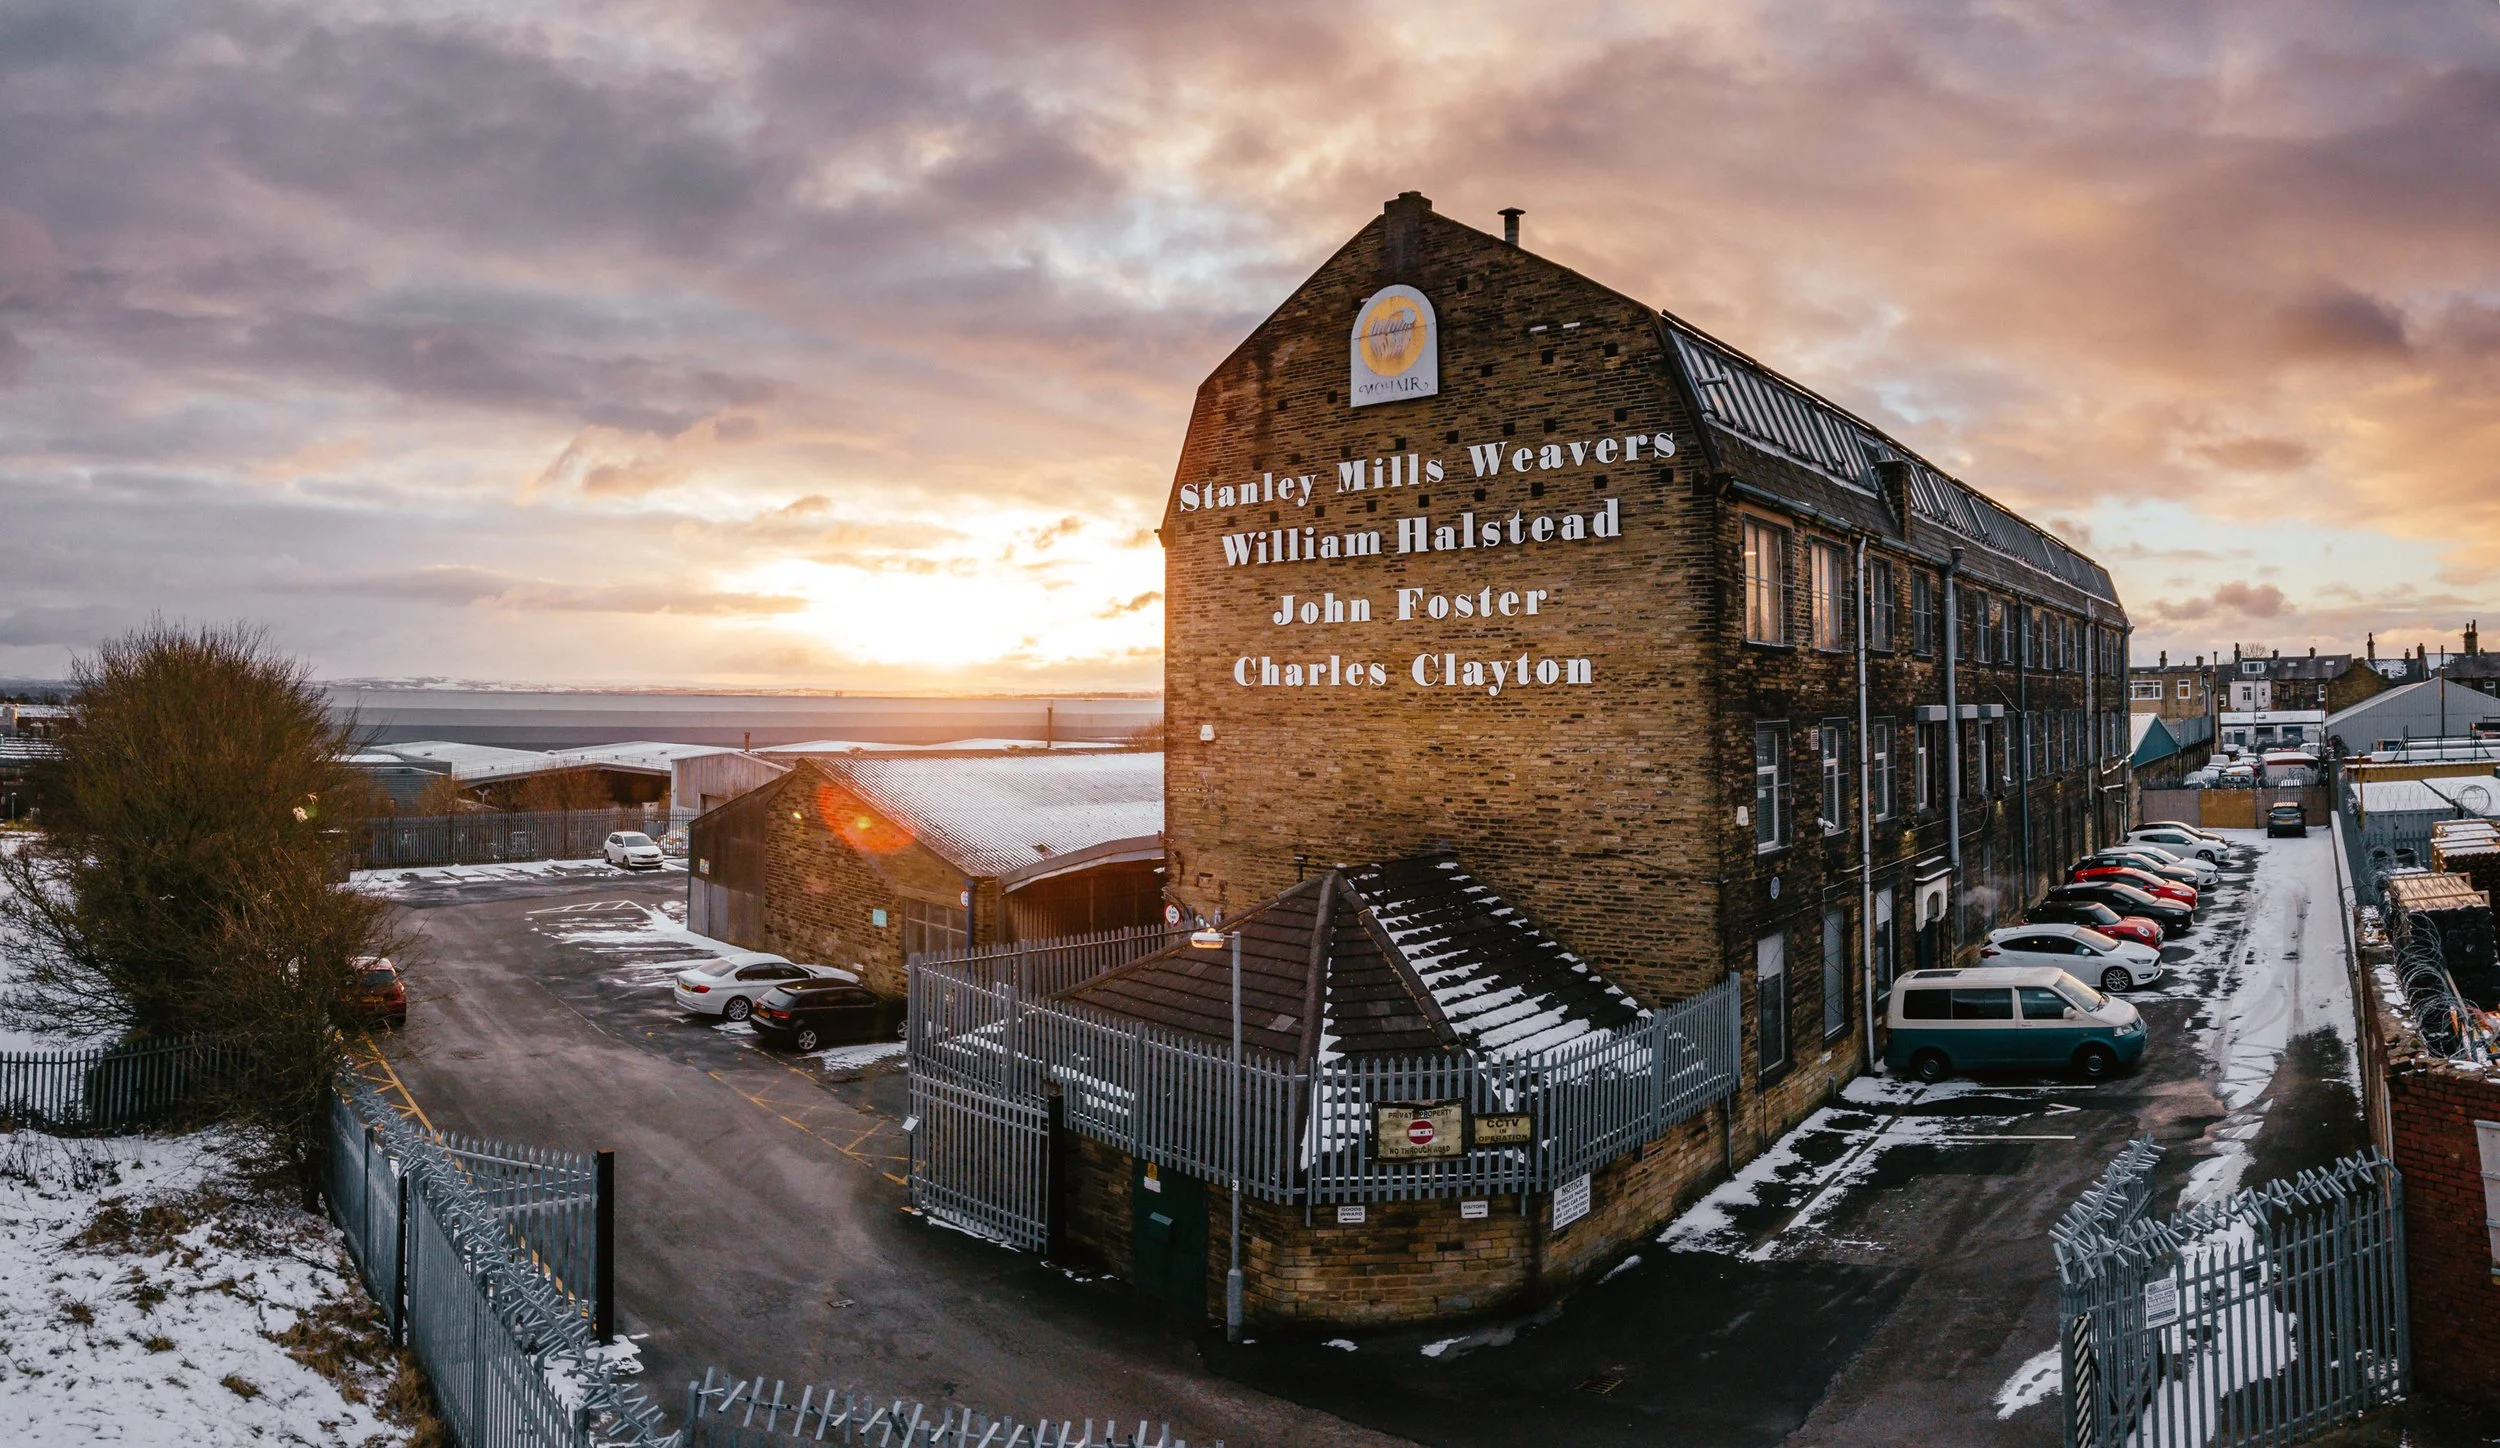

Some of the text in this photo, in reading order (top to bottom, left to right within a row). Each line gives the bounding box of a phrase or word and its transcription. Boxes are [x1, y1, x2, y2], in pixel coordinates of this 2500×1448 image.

[1180, 433, 1676, 512] Stanley Mills Weavers
[1222, 498, 1622, 567] William Halstead
[1273, 586, 1548, 626] John Foster
[1234, 653, 1593, 697] Charles Clayton
[1419, 1109, 1452, 1118] PROPERTY
[1487, 1118, 1519, 1128] CCTV
[1478, 1134, 1528, 1142] OPERATION
[1561, 1178, 1584, 1196] NOTICE
[1570, 1198, 1578, 1206] CAR
